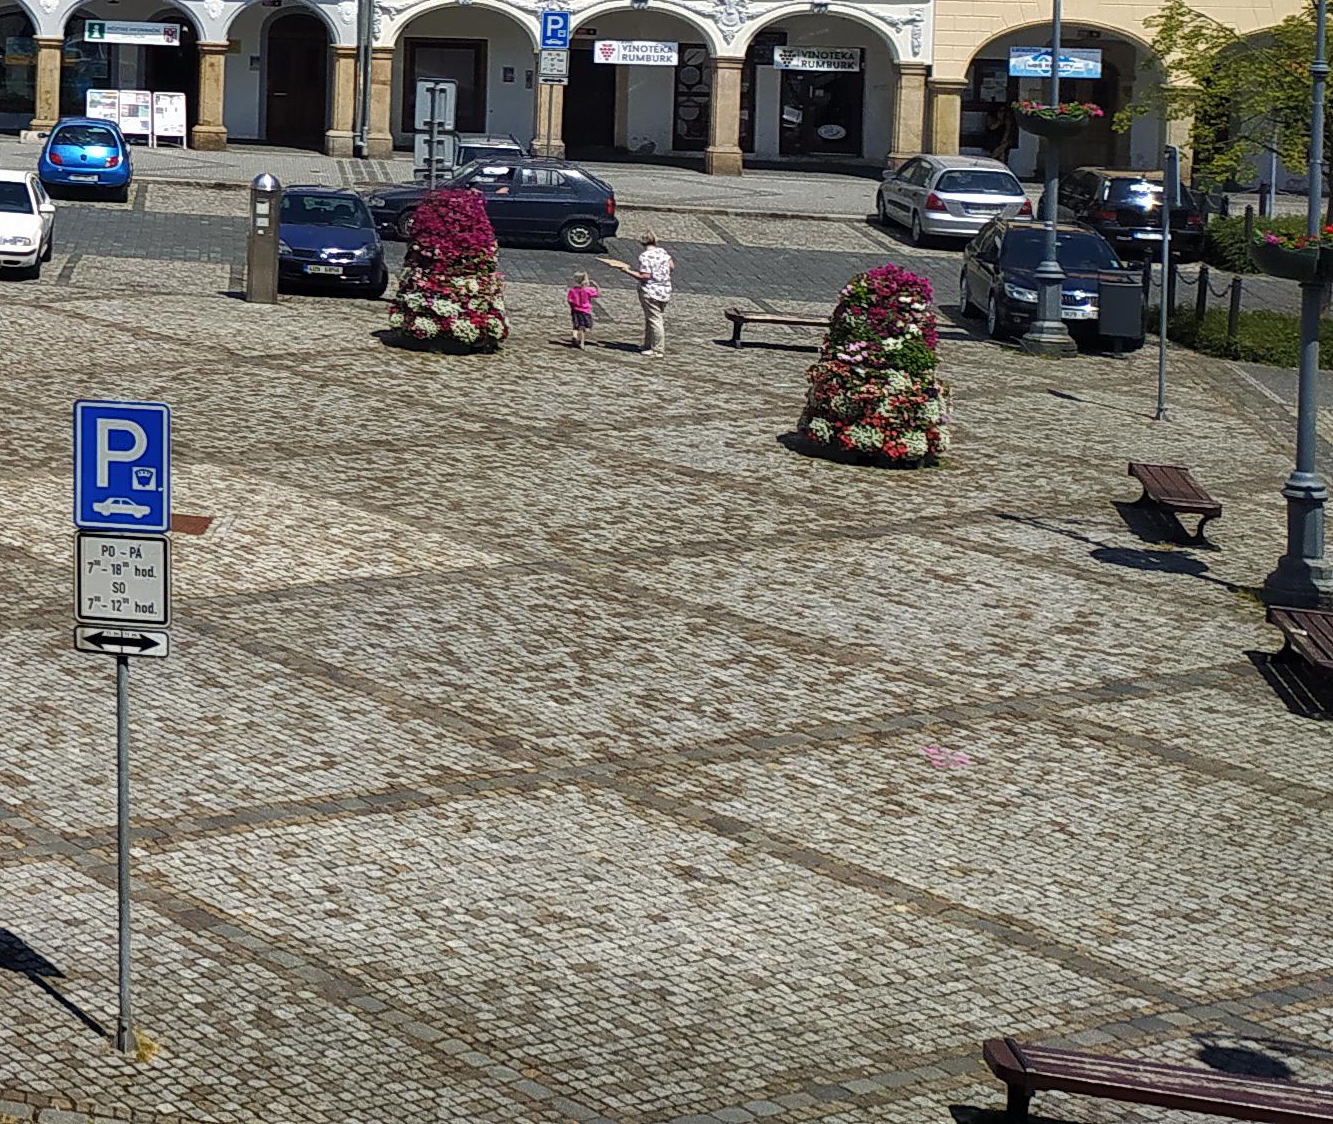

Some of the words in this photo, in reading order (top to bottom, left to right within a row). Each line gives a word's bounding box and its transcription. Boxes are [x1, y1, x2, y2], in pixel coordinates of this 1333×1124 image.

[546, 16, 564, 37] P
[621, 45, 673, 54] VINOTEKA
[801, 50, 855, 60] VINOTEKA
[621, 54, 673, 63] RUMBURK
[801, 60, 855, 69] RUMBURK
[96, 417, 148, 488] P
[101, 545, 116, 558] PO
[129, 544, 143, 559] PÁ
[134, 565, 158, 579] hod.
[111, 582, 126, 594] SO
[134, 601, 158, 615] hod.
